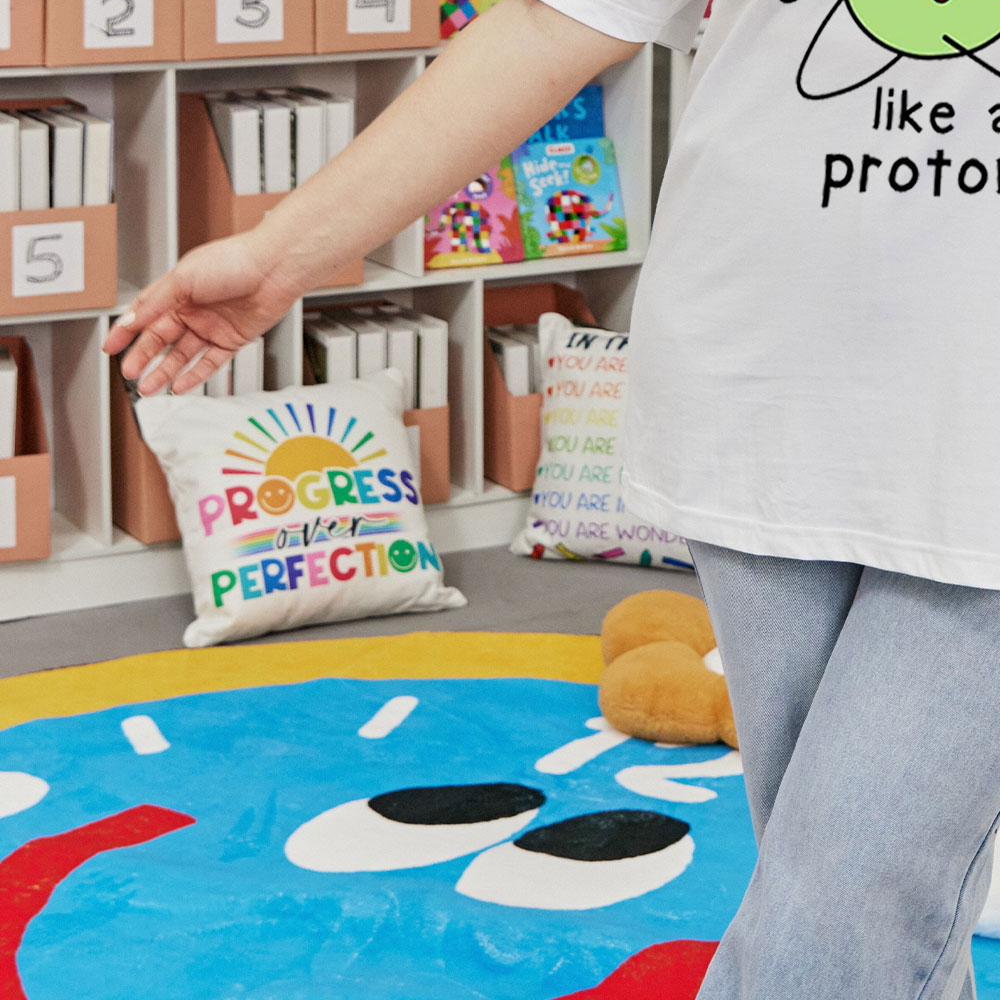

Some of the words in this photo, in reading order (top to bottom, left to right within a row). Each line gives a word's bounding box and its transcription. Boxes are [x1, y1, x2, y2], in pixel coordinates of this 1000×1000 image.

[873, 86, 956, 134] like
[522, 157, 557, 179] Hide
[529, 169, 569, 197] Seek!
[25, 233, 64, 284] 5
[566, 332, 597, 350] IN
[555, 356, 591, 371] YOU
[596, 356, 628, 373] ARE
[553, 381, 587, 397] YOU
[590, 381, 624, 399] ARE
[548, 435, 578, 453] YOU
[583, 436, 616, 455] ARE
[542, 464, 576, 481] YOU
[579, 465, 613, 484] ARE
[198, 467, 418, 537] PROGRESS
[540, 491, 572, 509] YOU
[576, 493, 611, 512] ARE
[277, 515, 391, 549] over
[576, 521, 610, 539] ARE
[211, 539, 440, 608] PERFECTION
